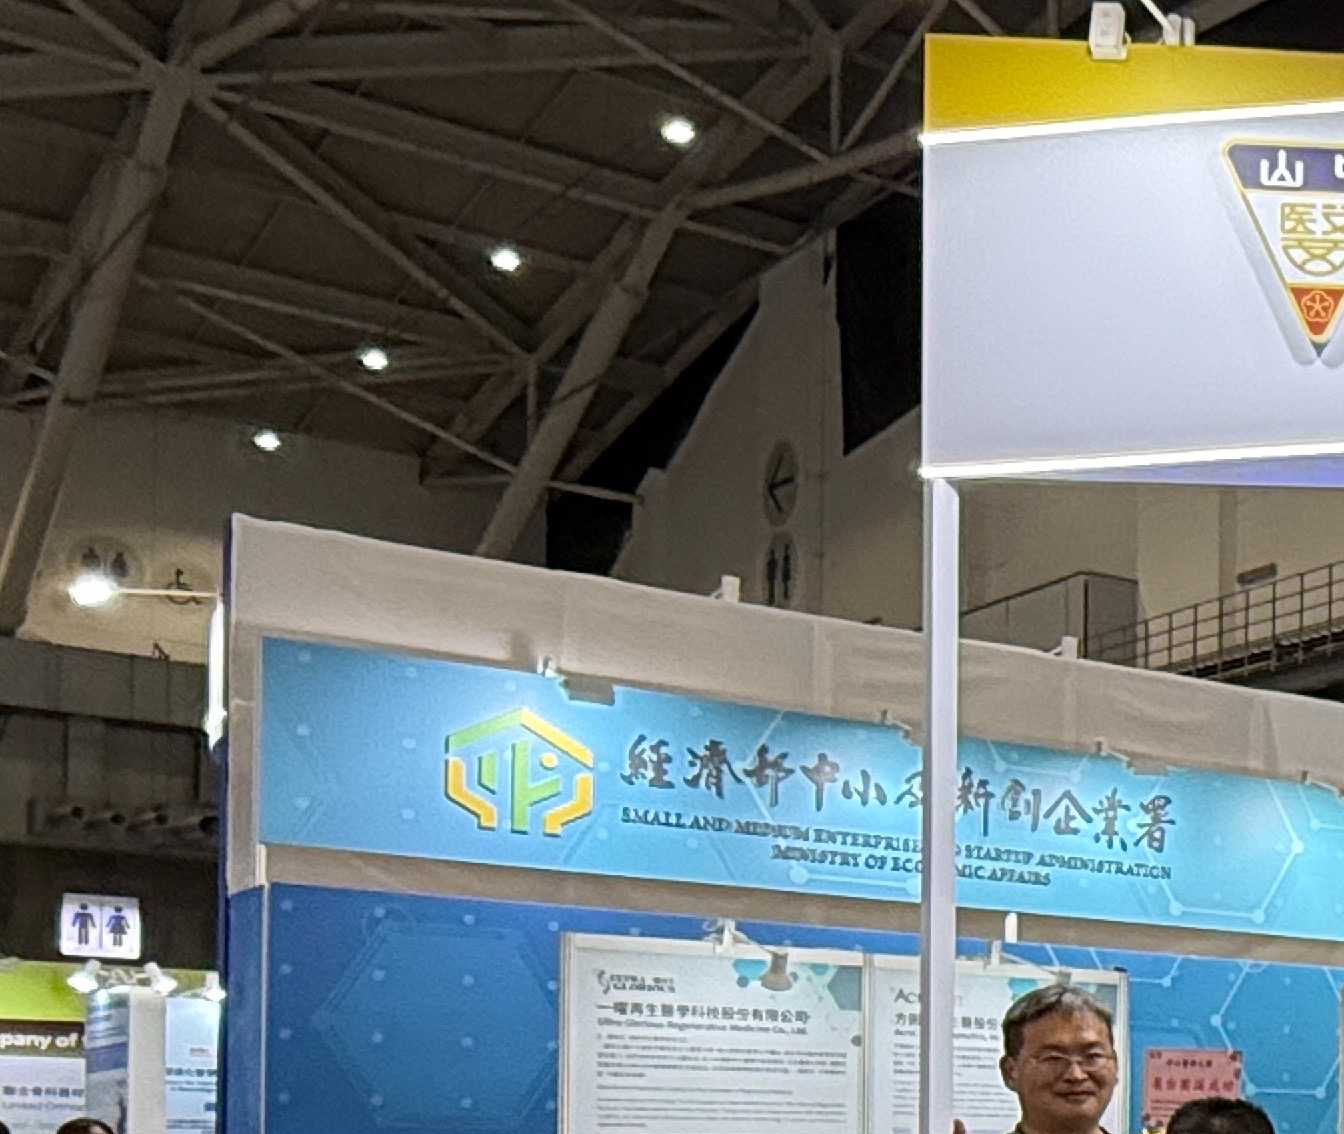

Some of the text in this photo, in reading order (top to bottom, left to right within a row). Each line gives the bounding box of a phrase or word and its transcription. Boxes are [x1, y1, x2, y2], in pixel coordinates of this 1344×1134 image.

[621, 806, 688, 830] SMALL
[689, 815, 730, 833] AND
[1036, 851, 1171, 880] ADMINISTRATION
[772, 845, 861, 869] MINISTRY
[864, 854, 885, 871] OF
[991, 867, 1051, 887] AFFAIRS
